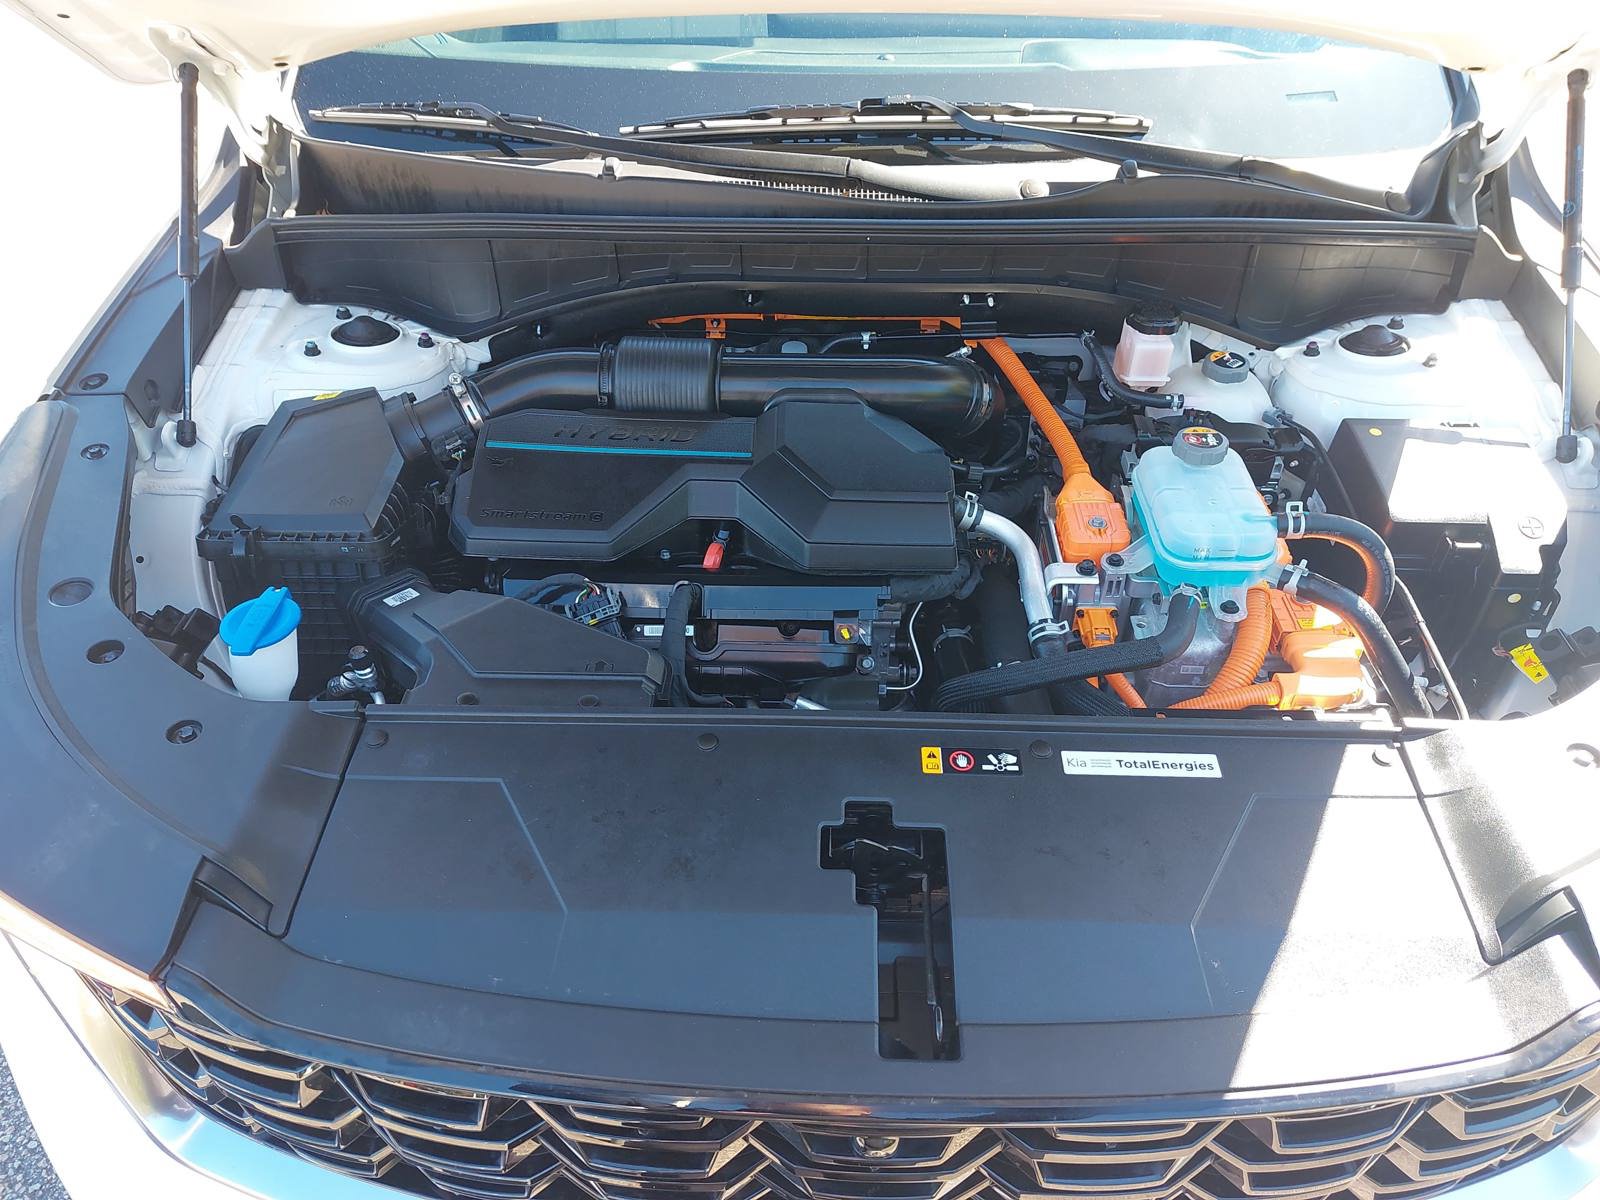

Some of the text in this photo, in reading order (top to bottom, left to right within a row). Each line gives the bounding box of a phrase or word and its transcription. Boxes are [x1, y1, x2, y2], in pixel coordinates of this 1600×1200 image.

[553, 424, 697, 443] HYBRID
[1066, 757, 1215, 772] Kia TotalEnergies
